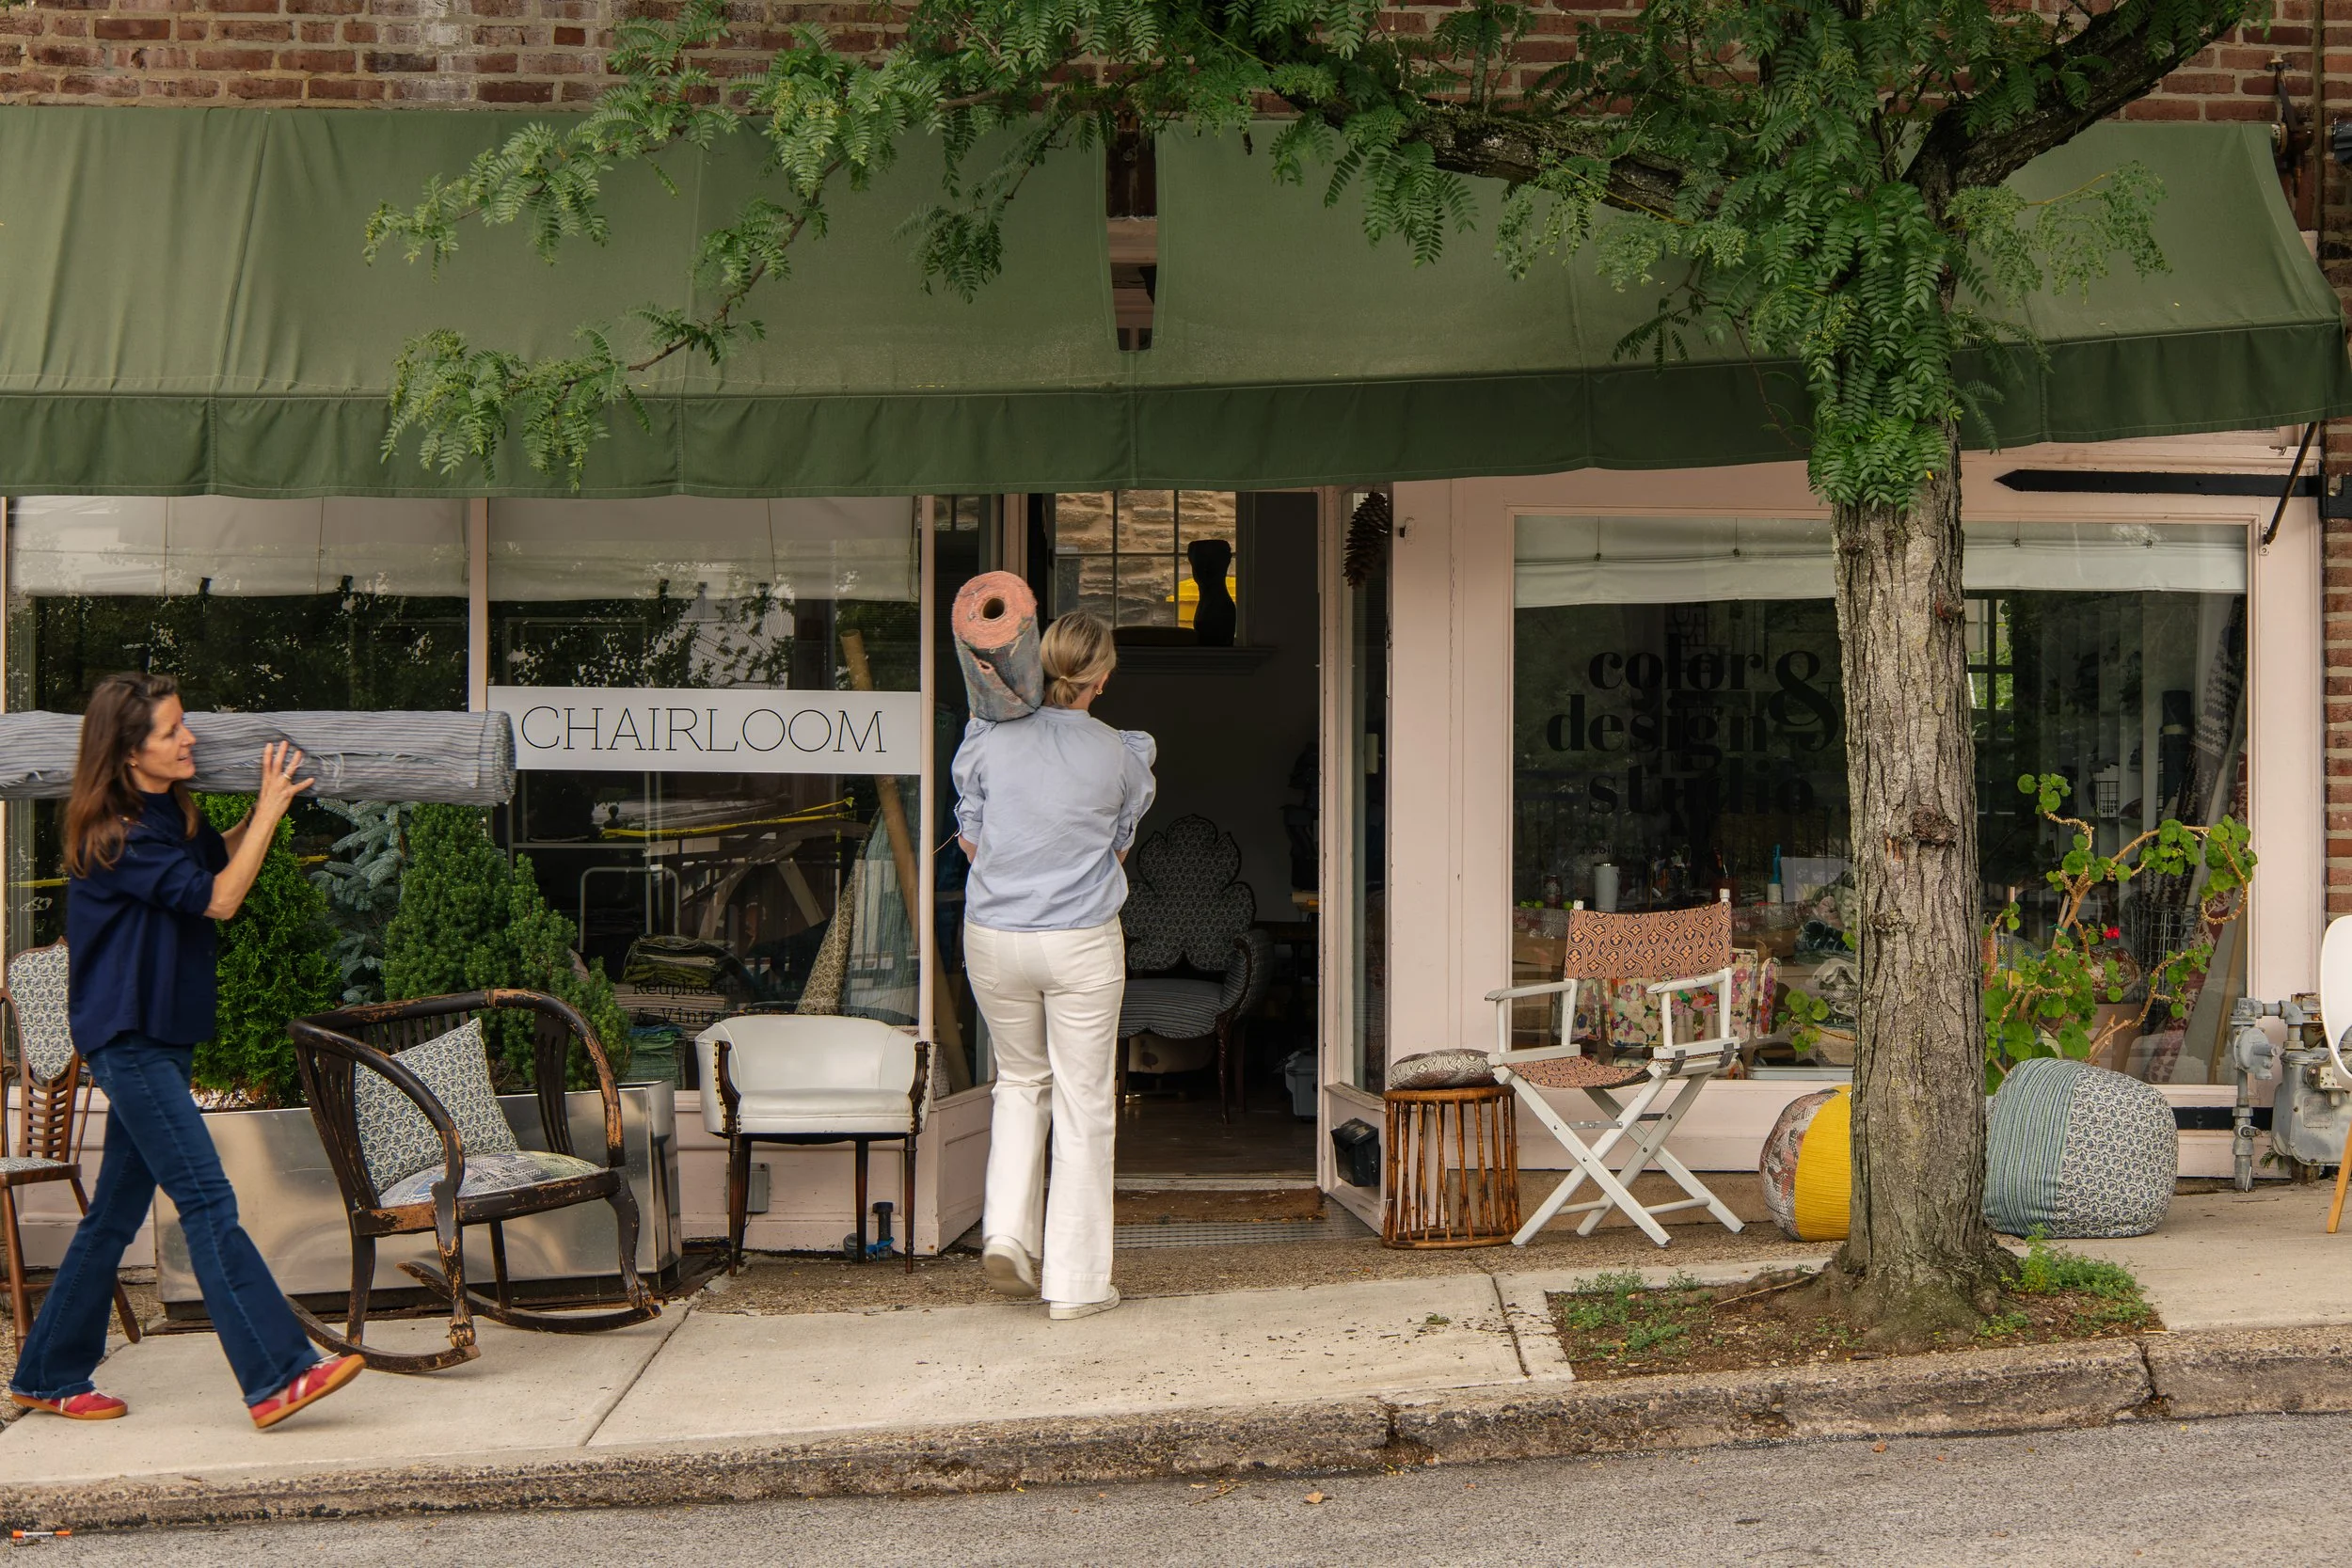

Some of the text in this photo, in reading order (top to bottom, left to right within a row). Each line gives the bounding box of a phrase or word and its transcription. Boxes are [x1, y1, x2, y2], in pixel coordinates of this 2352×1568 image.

[1588, 632, 1839, 752] color &
[520, 705, 887, 753] CHAIRLOOM
[1546, 693, 1768, 770] design
[1588, 757, 1814, 815] studio
